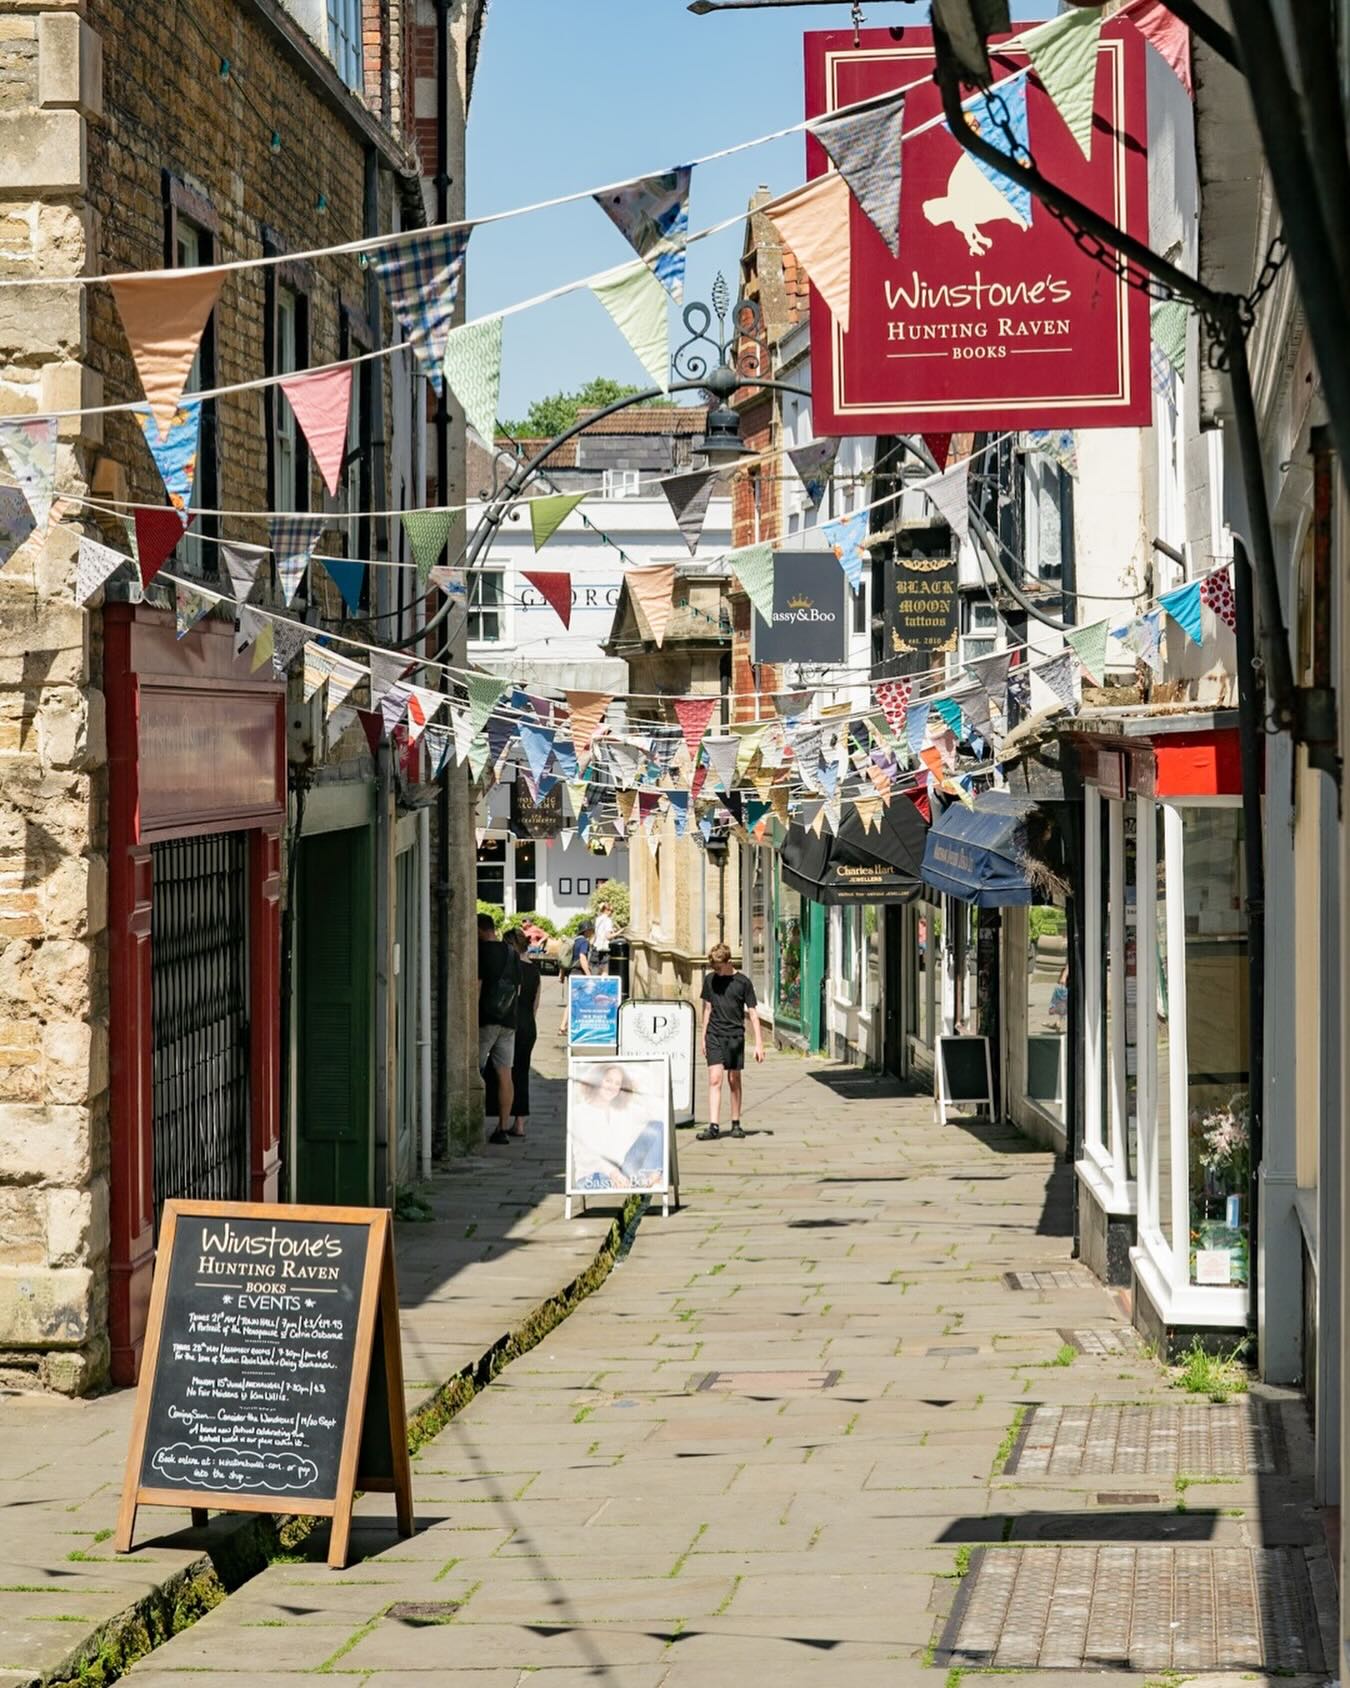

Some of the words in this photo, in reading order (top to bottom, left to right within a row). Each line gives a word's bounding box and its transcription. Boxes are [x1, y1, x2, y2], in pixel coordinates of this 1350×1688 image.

[884, 271, 1072, 310] Winstone's
[887, 322, 988, 341] HUNTING
[998, 317, 1071, 337] RAVEN
[952, 346, 1007, 360] BOOKS
[895, 580, 955, 595] BLACK
[898, 599, 952, 614] MOON
[772, 607, 836, 625] assy&Boo
[904, 615, 947, 627] tattoos
[837, 865, 874, 876] Charles
[875, 864, 895, 875] Hart
[653, 1016, 668, 1034] P
[202, 1222, 343, 1259] Winstone's
[197, 1256, 276, 1278] HUNTING
[281, 1260, 340, 1280] RAVEN
[246, 1282, 286, 1294] BOOKS
[237, 1294, 301, 1311] EVENTS
